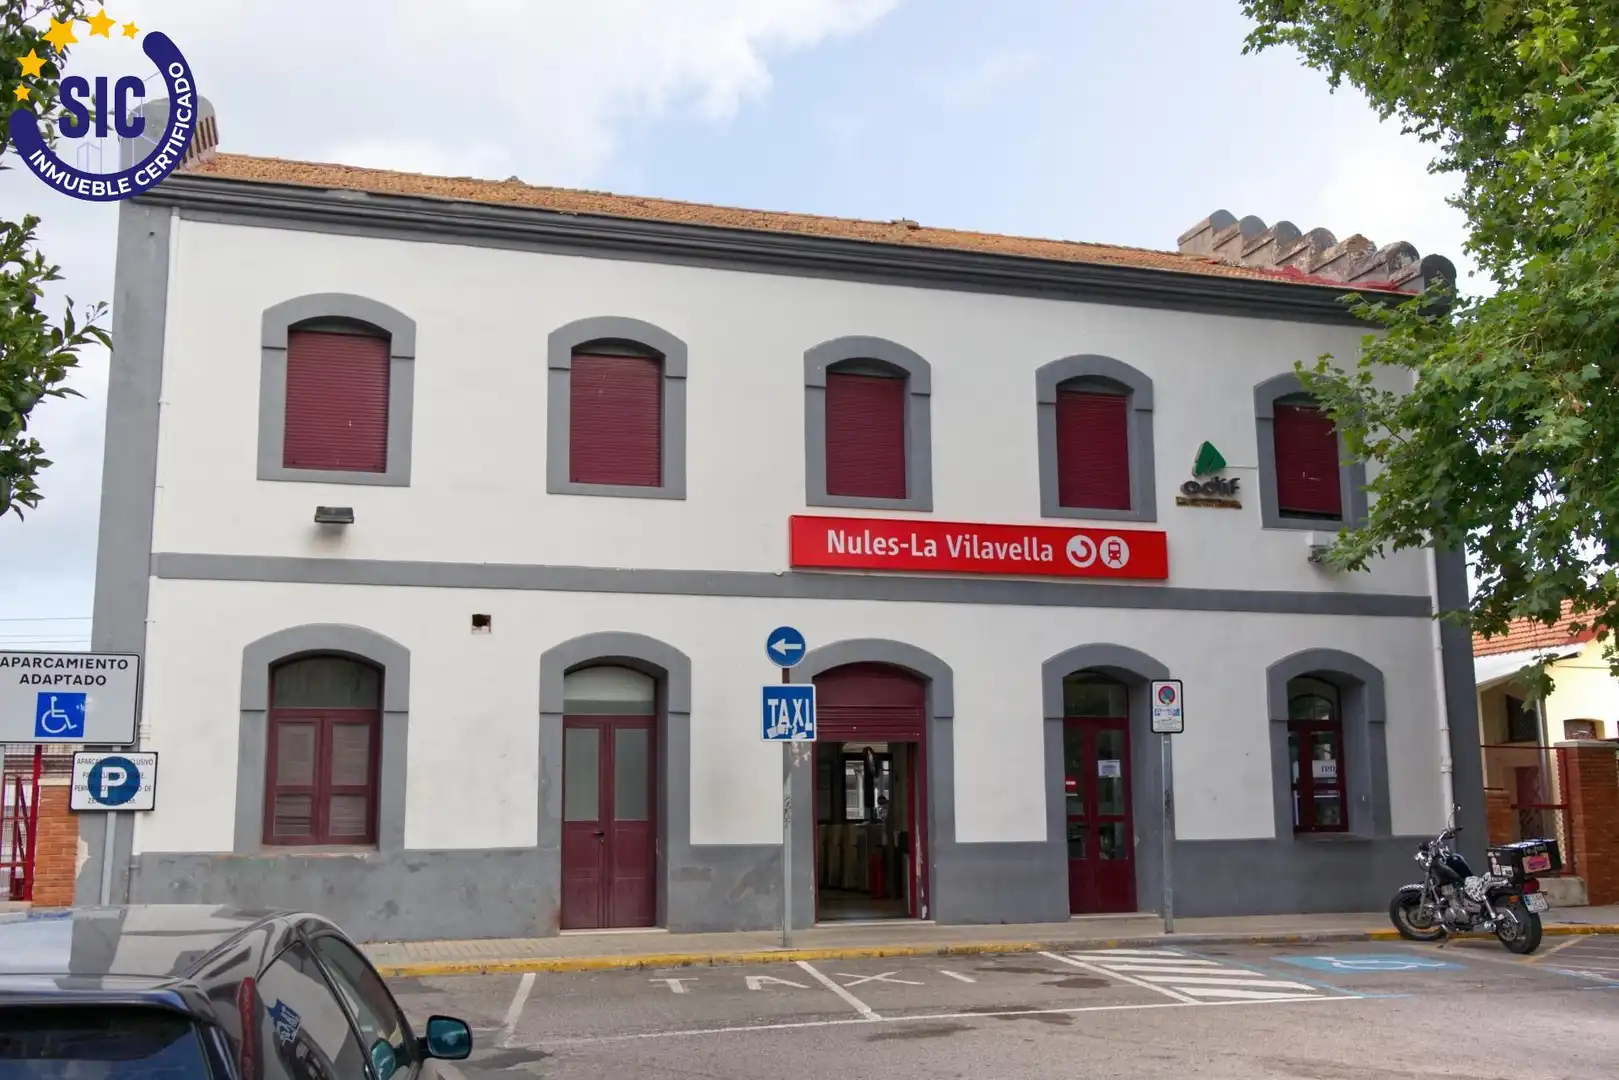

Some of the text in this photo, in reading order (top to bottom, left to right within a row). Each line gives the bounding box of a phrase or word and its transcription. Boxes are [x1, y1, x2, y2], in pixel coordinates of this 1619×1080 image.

[1180, 476, 1240, 497] adif
[826, 529, 1054, 562] Nules-La Vilavella
[0, 656, 129, 670] APARCAMIENTO
[19, 673, 107, 686] ADAPTADO
[767, 698, 811, 728] TAXI
[649, 970, 977, 993] TAXI
